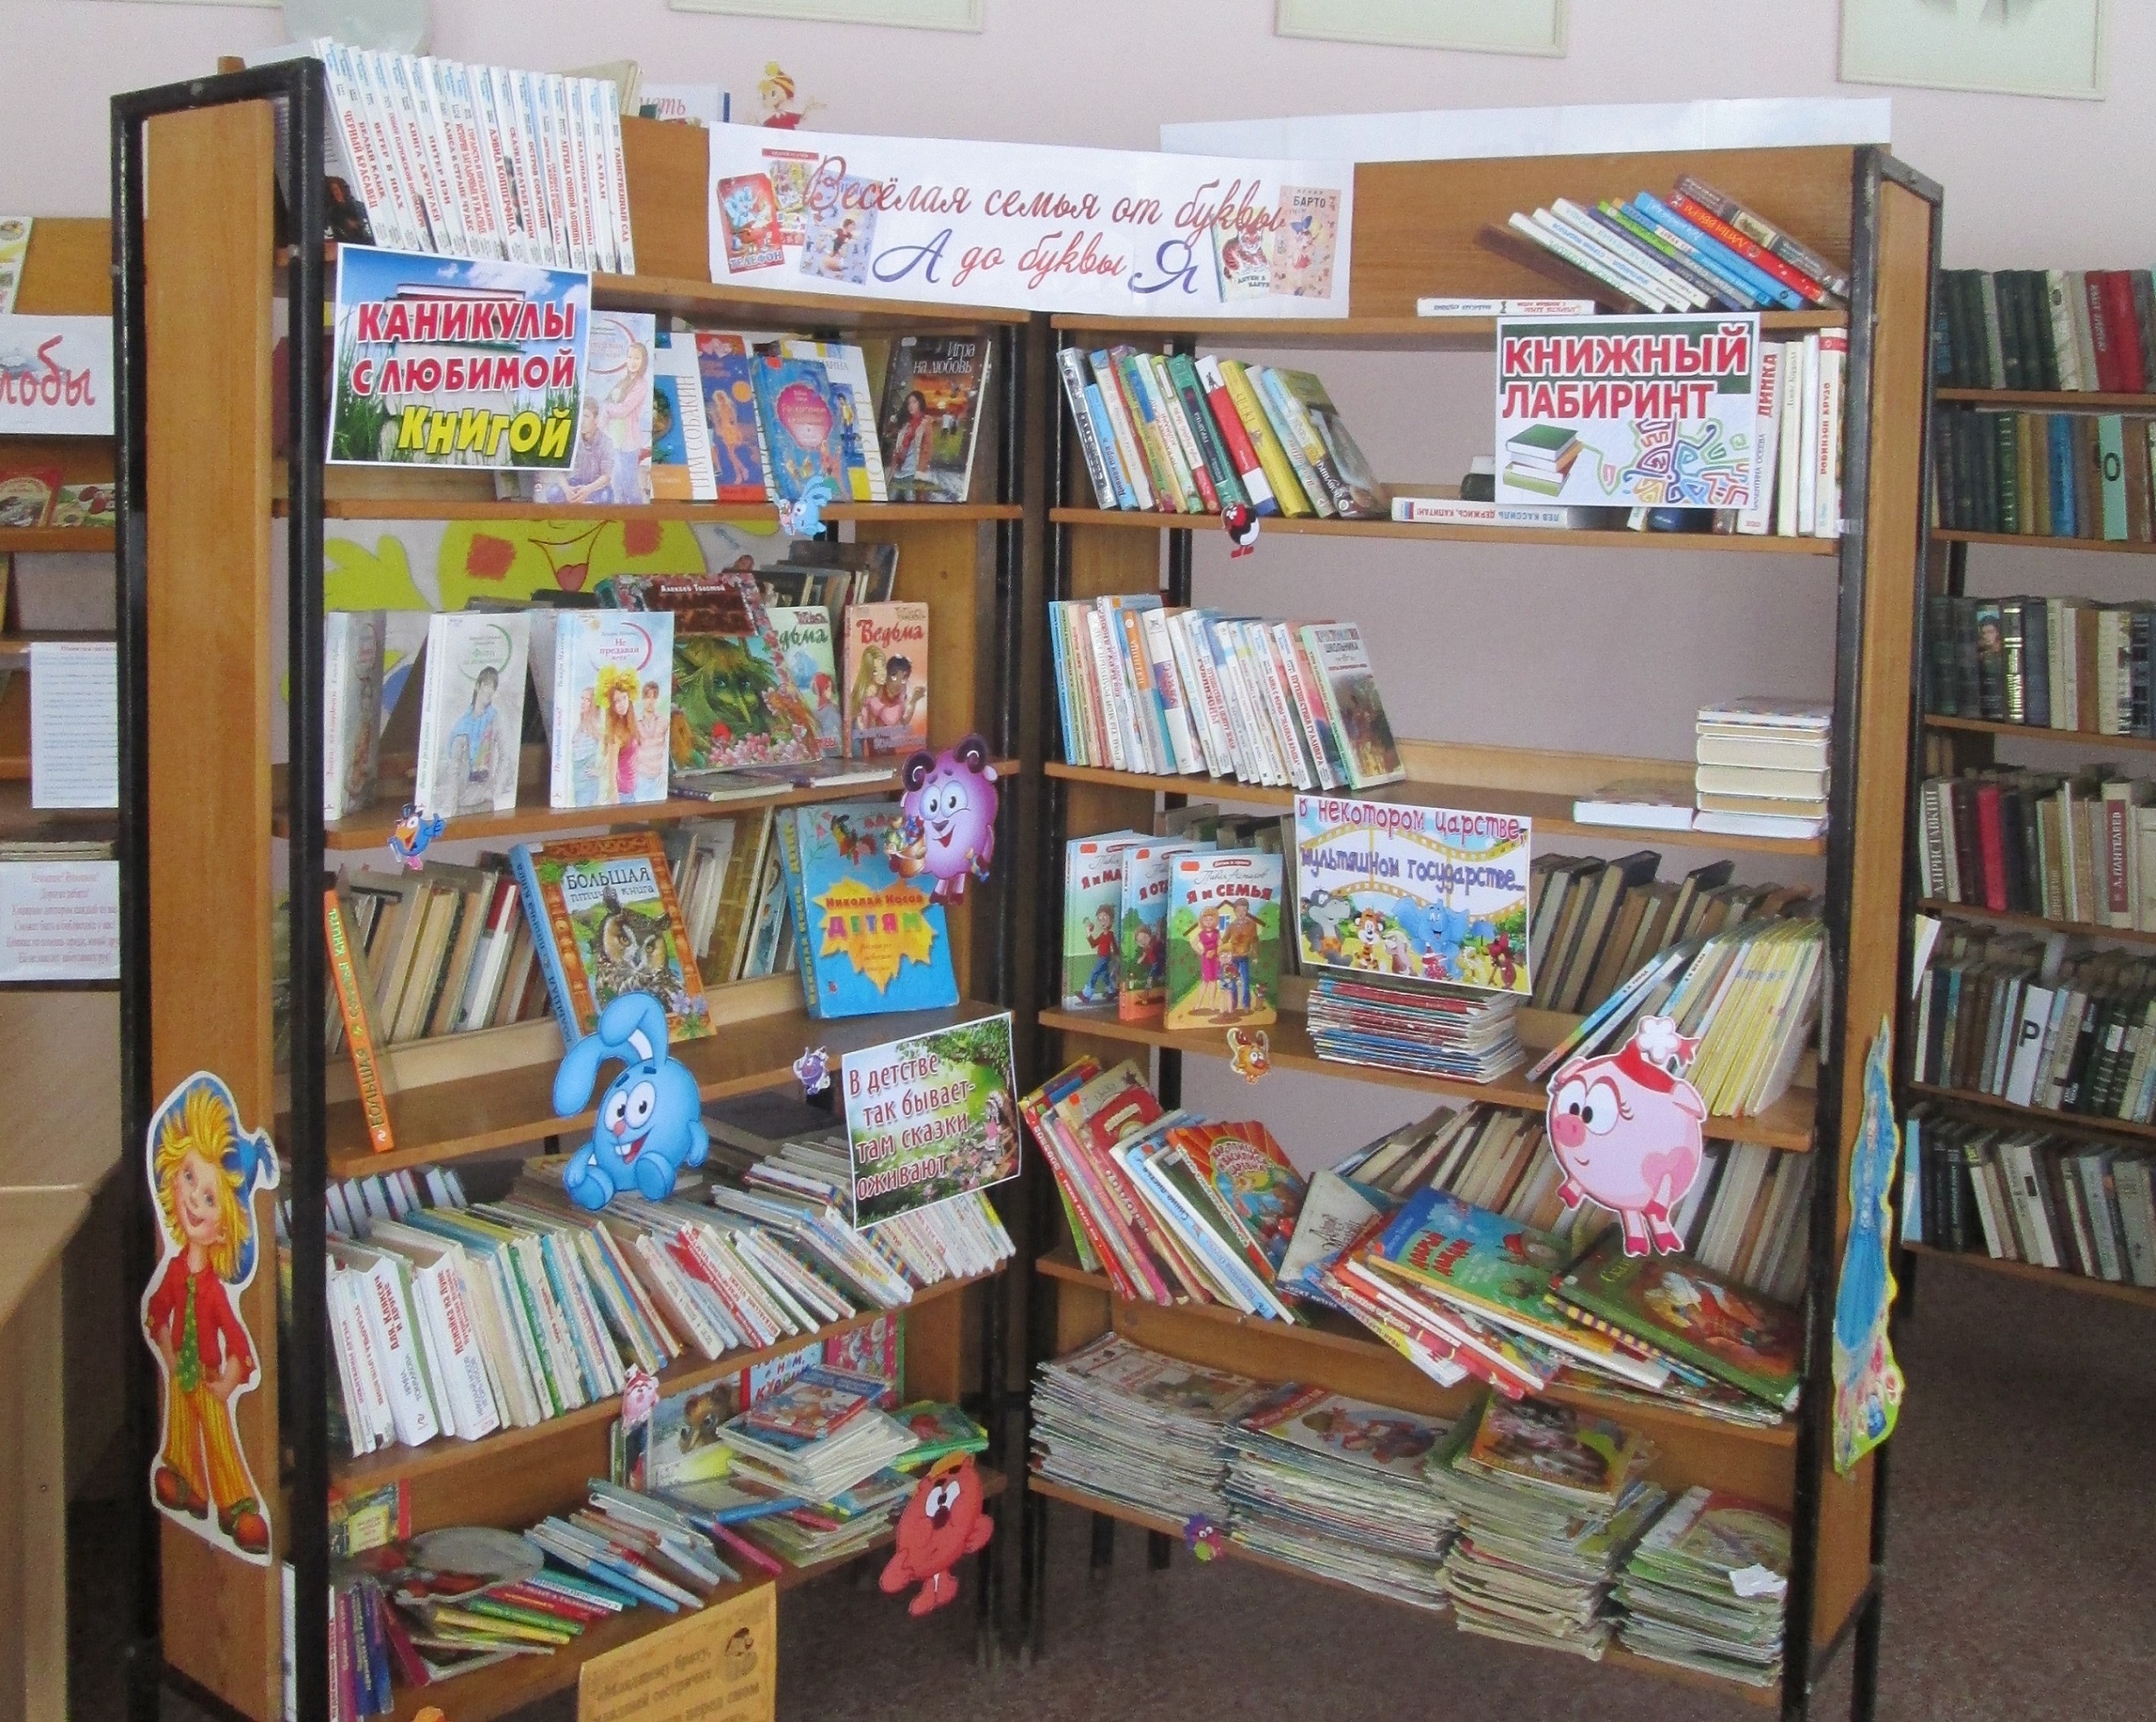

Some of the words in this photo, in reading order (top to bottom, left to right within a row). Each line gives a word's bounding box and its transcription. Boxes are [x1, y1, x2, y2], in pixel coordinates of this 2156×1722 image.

[342, 110, 362, 154] ЧЕРНЫЙ
[354, 154, 378, 209] КРАСАВЕЦ
[373, 121, 390, 158] ВЕТЕР
[389, 176, 405, 210] ИВАХ
[407, 121, 424, 158] КНИГА
[418, 161, 441, 222] ДЖУНГЛЕЙ
[427, 134, 444, 176] ПИТЕР
[526, 141, 539, 176] ОСТРОВ
[441, 119, 457, 154] АЛИСА
[452, 162, 467, 199] СТРАНЕ
[460, 199, 475, 232] ЧУДЕС
[487, 127, 503, 162] ДЭВИД
[495, 164, 517, 236] КОППЕРФИЛД
[508, 125, 522, 164] СКАЗКИ
[522, 207, 535, 240] ГРИММ
[595, 152, 607, 200] ХАЙДИ
[613, 145, 628, 222] ТАИНСТВЕННЫЙ
[621, 223, 630, 243] САД
[803, 154, 971, 212] Весёлая
[985, 189, 1101, 219] семья
[1112, 197, 1162, 226] от
[1175, 179, 1286, 250] буквы
[1292, 195, 1326, 208] БАРТО
[1715, 221, 1750, 250] ЛАПЫ
[729, 250, 782, 270] ТЕЛЕФОН
[872, 228, 953, 283] А
[951, 246, 1004, 287] до
[1017, 231, 1127, 290] буквы
[1128, 240, 1198, 294] Я
[357, 303, 576, 342] КАНИКУЛЫ
[913, 361, 928, 374] на
[929, 360, 972, 376] любовь
[947, 341, 976, 360] Игра
[1504, 325, 1748, 376] КНИЖНЫЙ
[352, 359, 373, 396] С
[379, 348, 576, 395] ЛЮБИМОЙ
[1757, 352, 1777, 418] ДИНКА
[1503, 383, 1716, 420] ЛАБИРИНТ
[1822, 382, 1830, 415] КРУЗО
[1819, 419, 1829, 475] РОБИНЗОН
[1416, 507, 1453, 517] КАПИТАН!
[1455, 508, 1496, 518] ДЕРЖИСЬ,
[1497, 510, 1539, 521] КАССИЛЬ
[1542, 512, 1560, 521] ЛЕВ
[615, 638, 627, 647] Не
[856, 619, 924, 648] Ведьма
[1305, 724, 1325, 767] ГУЛЛИВЕРА
[1318, 800, 1424, 833] некотором
[1435, 812, 1526, 845] царстве,
[566, 867, 651, 890] БОЛЬШАЯ
[1081, 876, 1090, 889] Я
[1102, 868, 1122, 883] МА
[1300, 846, 1400, 877] мультяшном
[570, 889, 617, 902] птичя
[621, 883, 655, 898] книга
[825, 896, 882, 908] Николай
[1139, 887, 1147, 900] Я
[1150, 880, 1168, 895] ОТ
[1186, 889, 1197, 904] Я
[1216, 884, 1273, 901] СЕМЬЯ
[828, 912, 921, 941] ДЕТЯМ
[2019, 1020, 2040, 1047] Р
[352, 1045, 386, 1130] БОЛЬШАЯ
[850, 1070, 859, 1096] В
[868, 1055, 938, 1094] детстве
[864, 1099, 896, 1127] так
[902, 1080, 975, 1116] бывает-
[856, 1136, 895, 1163] там
[902, 1113, 968, 1149] сказки
[857, 1155, 946, 1201] оживают
[372, 1274, 393, 1324] Кляксич
[435, 1269, 449, 1296] Луне
[443, 1295, 452, 1309] на
[444, 1309, 465, 1356] Незнайка
[461, 1355, 475, 1382] НОСОВ
[467, 1382, 484, 1417] НИКОЛАЙ
